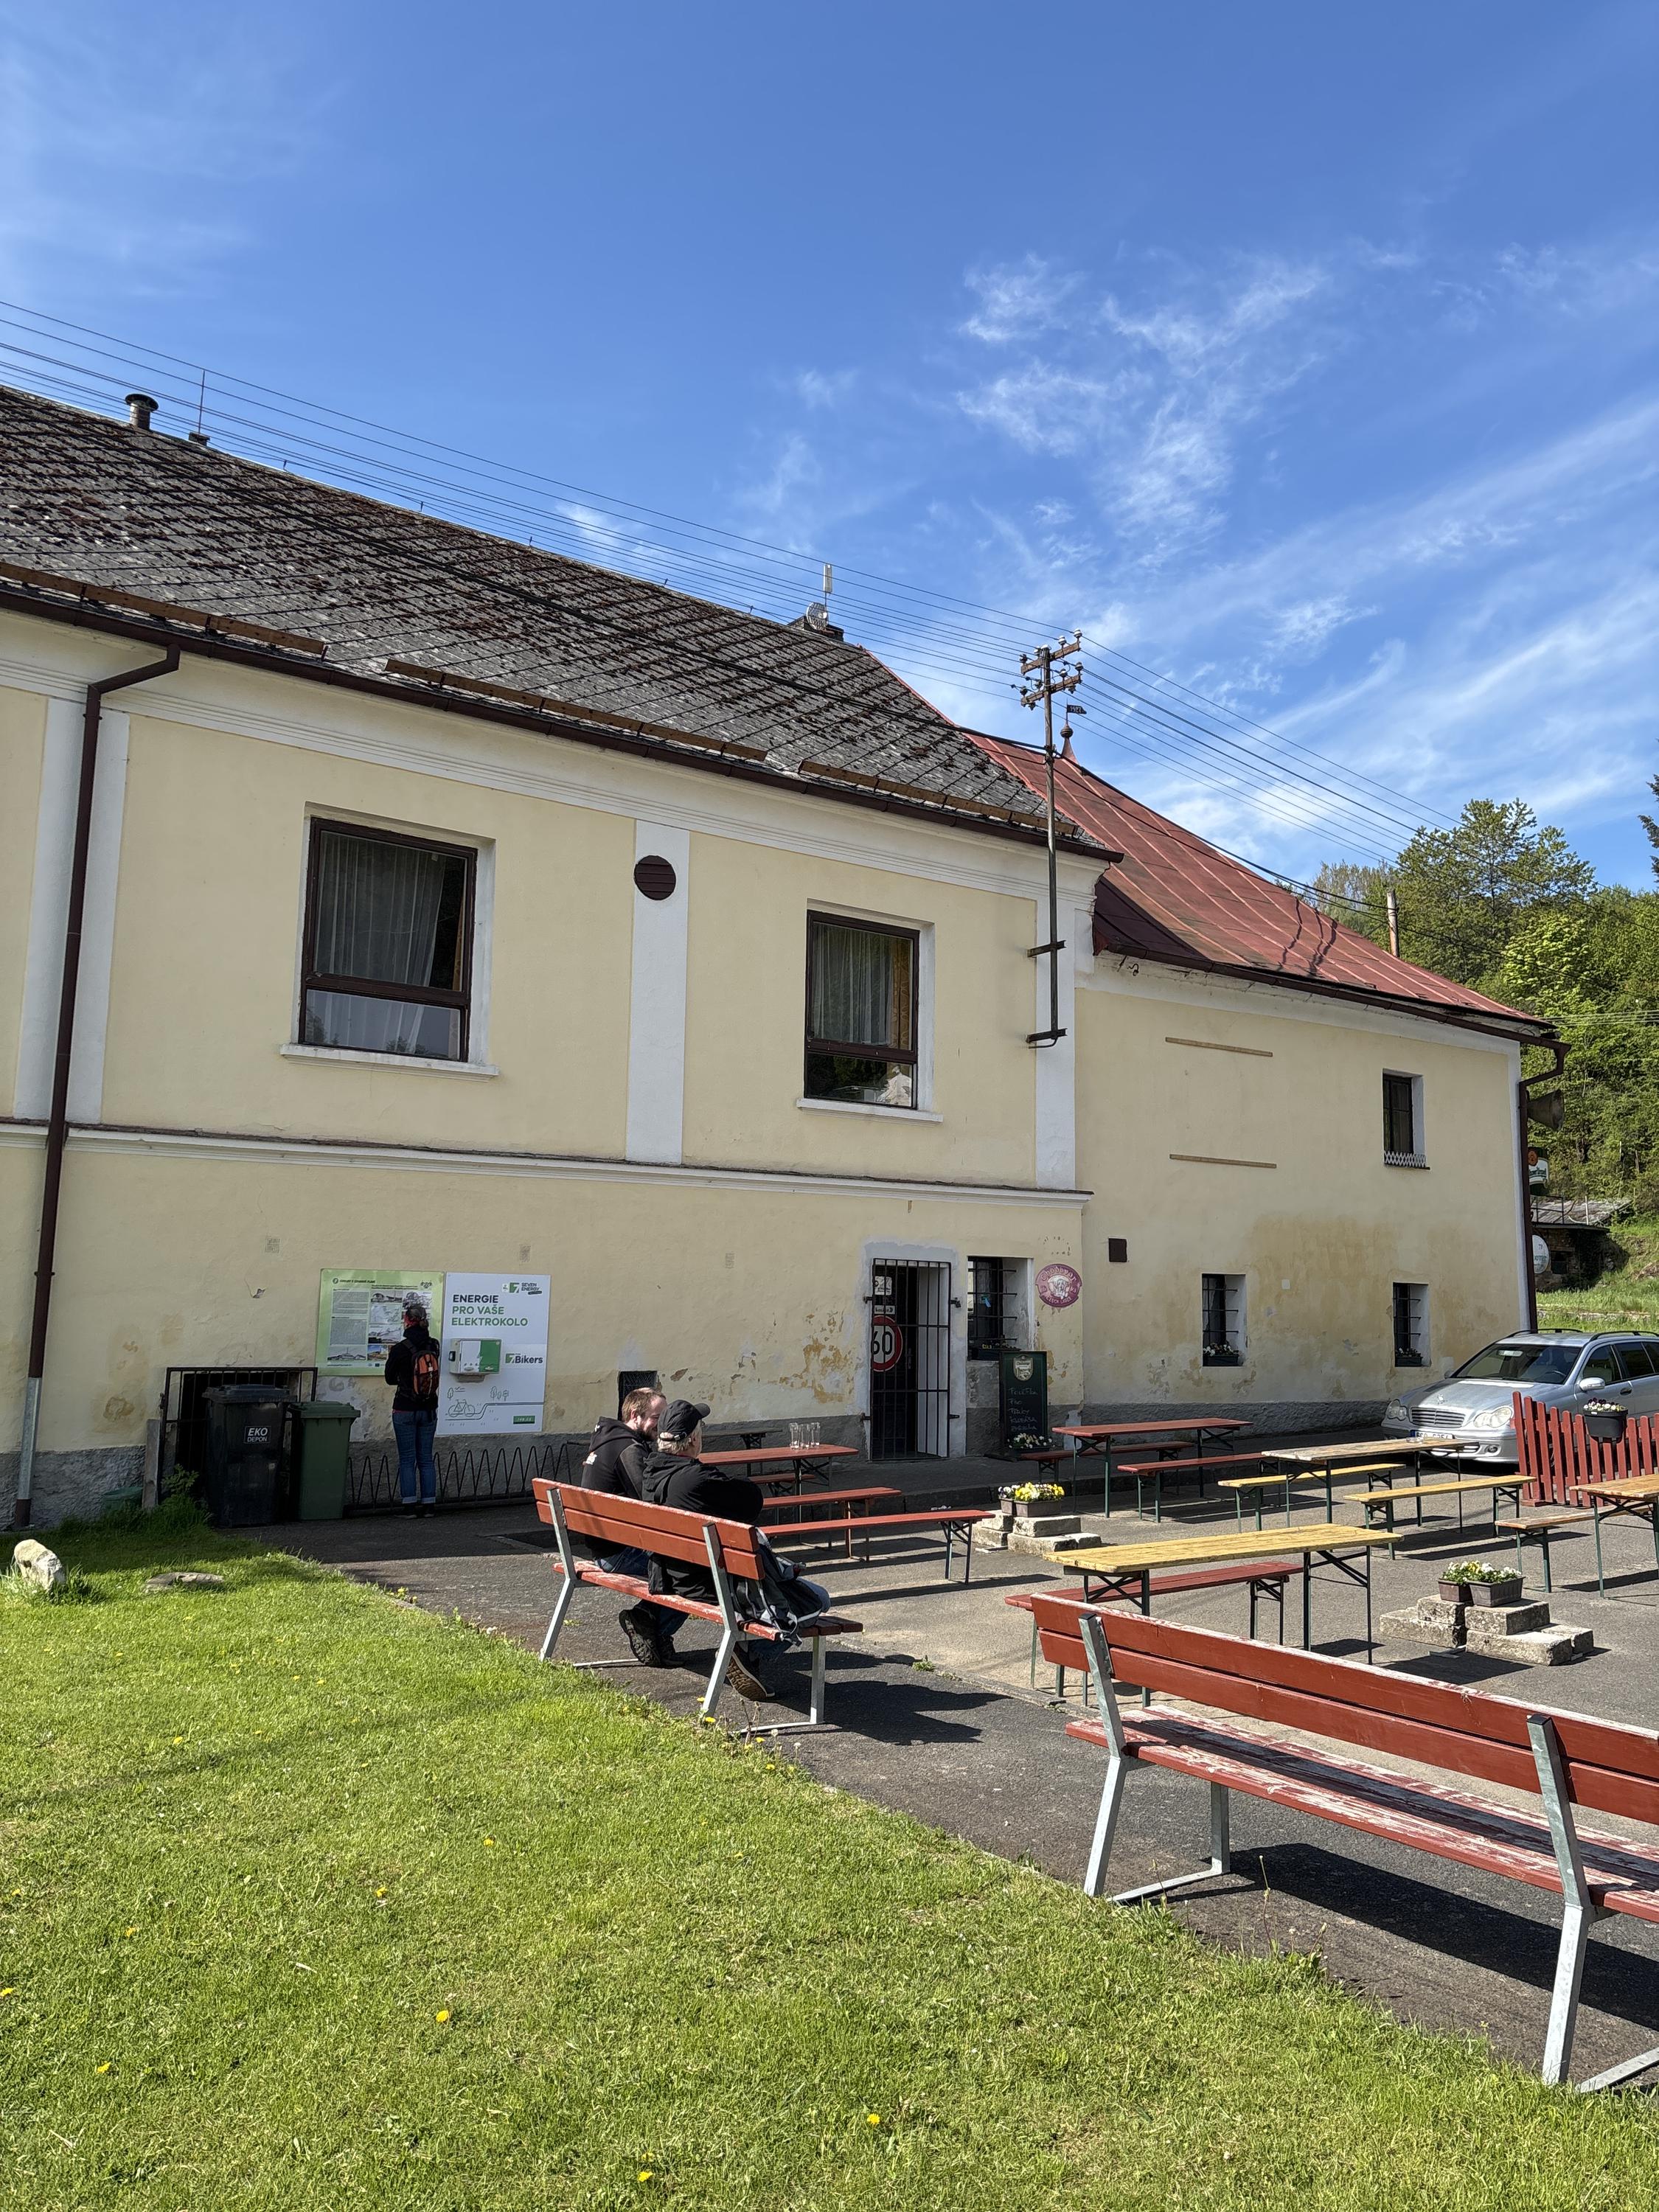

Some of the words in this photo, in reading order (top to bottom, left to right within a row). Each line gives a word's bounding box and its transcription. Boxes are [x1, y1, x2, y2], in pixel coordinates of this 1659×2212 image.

[1040, 1265, 1077, 1281] Chodovar
[453, 1294, 499, 1303] ENERGIE
[452, 1306, 474, 1315] PRO
[477, 1304, 504, 1315] VAŠE
[451, 1318, 528, 1326] ELEKTROKOLO
[515, 1354, 543, 1363] Bikers
[248, 1427, 268, 1436] EKO
